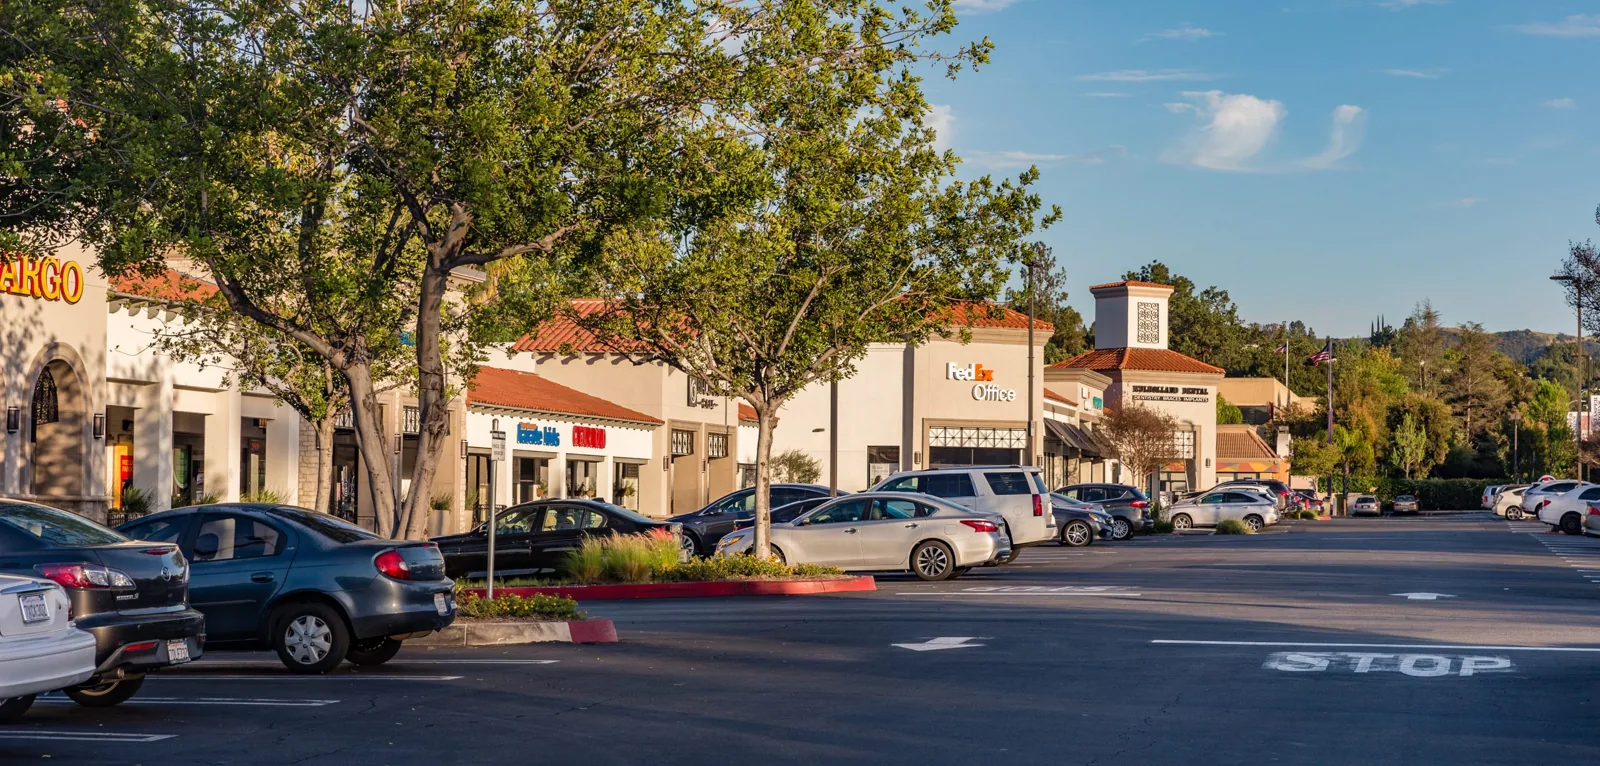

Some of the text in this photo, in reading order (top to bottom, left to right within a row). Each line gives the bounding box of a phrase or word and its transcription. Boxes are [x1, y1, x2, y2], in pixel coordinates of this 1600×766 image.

[946, 361, 994, 381] FedEx
[971, 383, 1016, 402] Office
[1132, 386, 1209, 395] MULHOLLAND DENTAL
[1268, 651, 1513, 677] STOP
